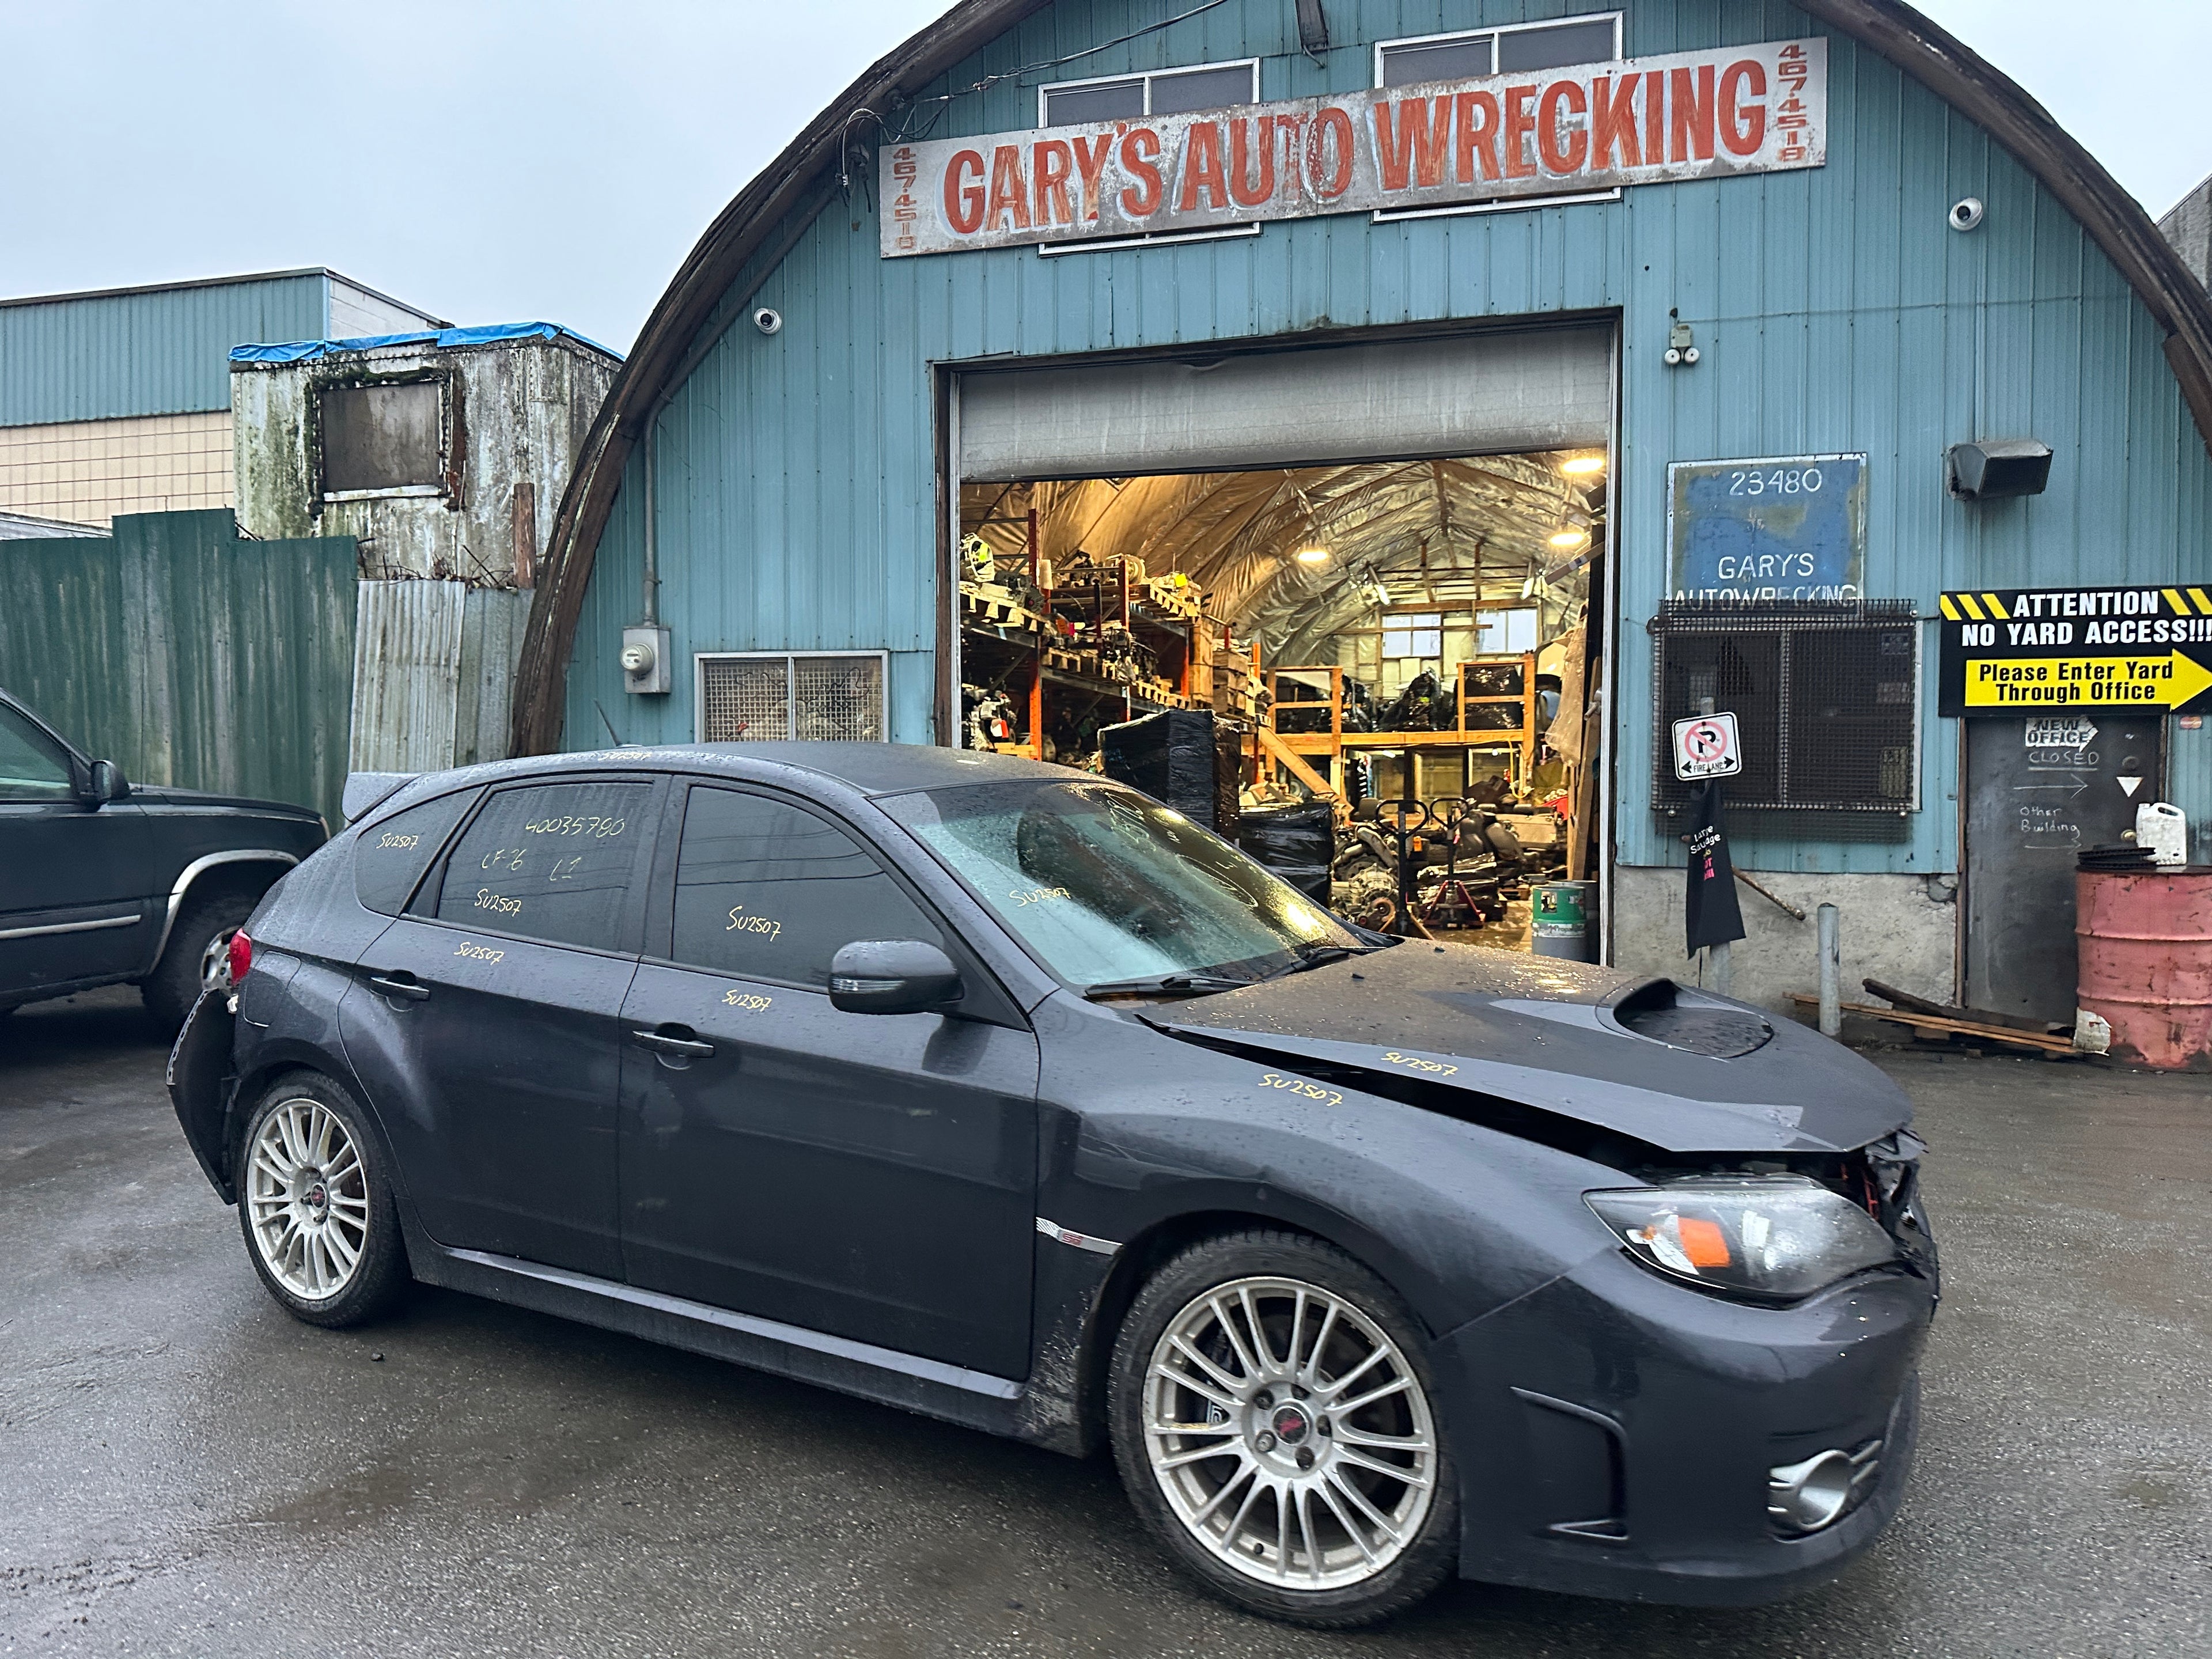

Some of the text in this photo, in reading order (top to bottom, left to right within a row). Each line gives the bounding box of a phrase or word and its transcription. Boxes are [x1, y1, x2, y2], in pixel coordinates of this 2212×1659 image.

[944, 59, 1767, 235] GARY'S AUTO WRECKING
[1729, 468, 1823, 496] 23480
[1718, 552, 1815, 579] GARY'S
[2013, 591, 2159, 618] ATTENTION
[1961, 619, 2212, 646] NO YARD ACCESS!!!
[1979, 660, 2173, 681] Please Enter Yard
[1995, 682, 2156, 703] Through Office
[2034, 718, 2078, 730] NEW
[2027, 730, 2089, 744] OFFICE
[1694, 764, 1706, 772] FIRE
[2029, 750, 2100, 766] CLOSED
[2020, 806, 2062, 816] Other
[376, 832, 419, 850] SU2507
[2021, 819, 2081, 841] Building
[474, 888, 522, 917] SU2507
[726, 906, 781, 941] SU2507
[454, 942, 504, 965] SU2507
[722, 989, 771, 1012] SU2507
[1381, 1052, 1459, 1076] SU2507
[1258, 1074, 1343, 1107] SU2507
